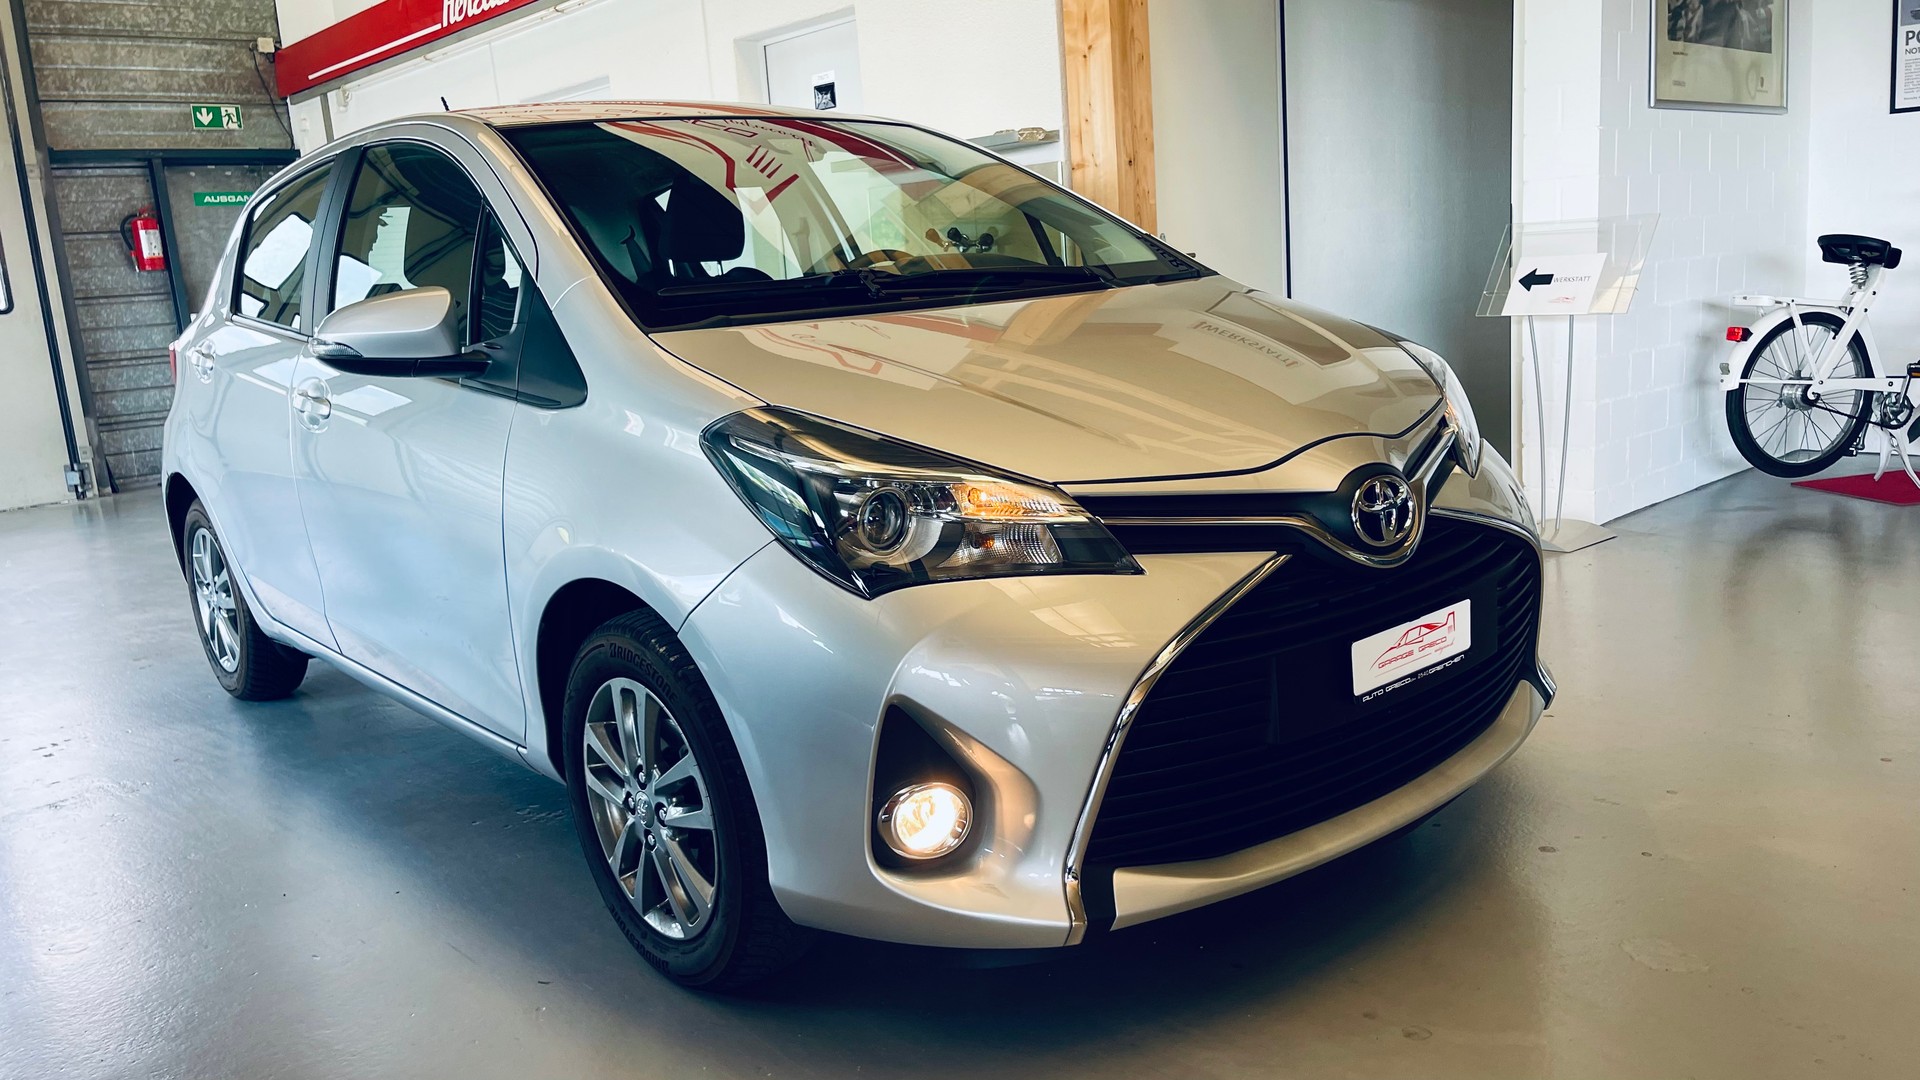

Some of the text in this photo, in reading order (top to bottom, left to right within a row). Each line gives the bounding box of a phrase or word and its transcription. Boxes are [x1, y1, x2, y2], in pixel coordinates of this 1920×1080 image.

[1378, 636, 1447, 669] GARAGE GRECO
[609, 642, 678, 703] BRIDGESTONE
[1363, 689, 1384, 702] AUTO
[1385, 677, 1411, 692] GRECO
